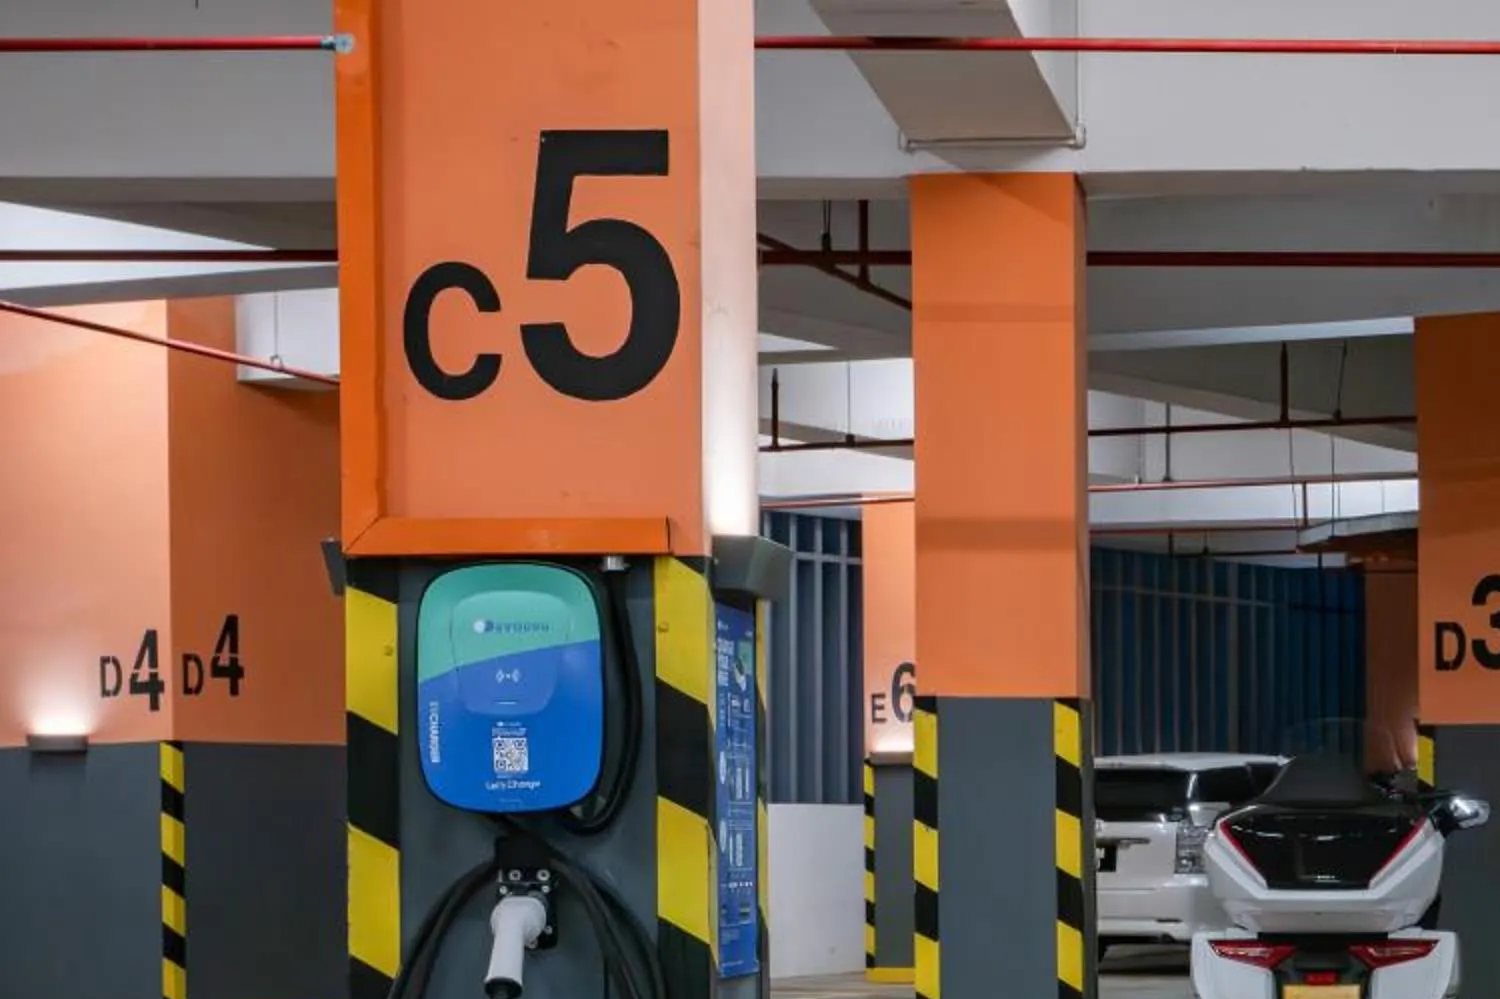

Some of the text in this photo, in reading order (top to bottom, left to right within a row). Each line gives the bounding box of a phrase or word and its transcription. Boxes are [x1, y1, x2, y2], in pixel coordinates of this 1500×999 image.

[403, 128, 681, 402] C5
[100, 629, 165, 711] D4
[182, 614, 245, 697] D4
[871, 661, 916, 723] E6
